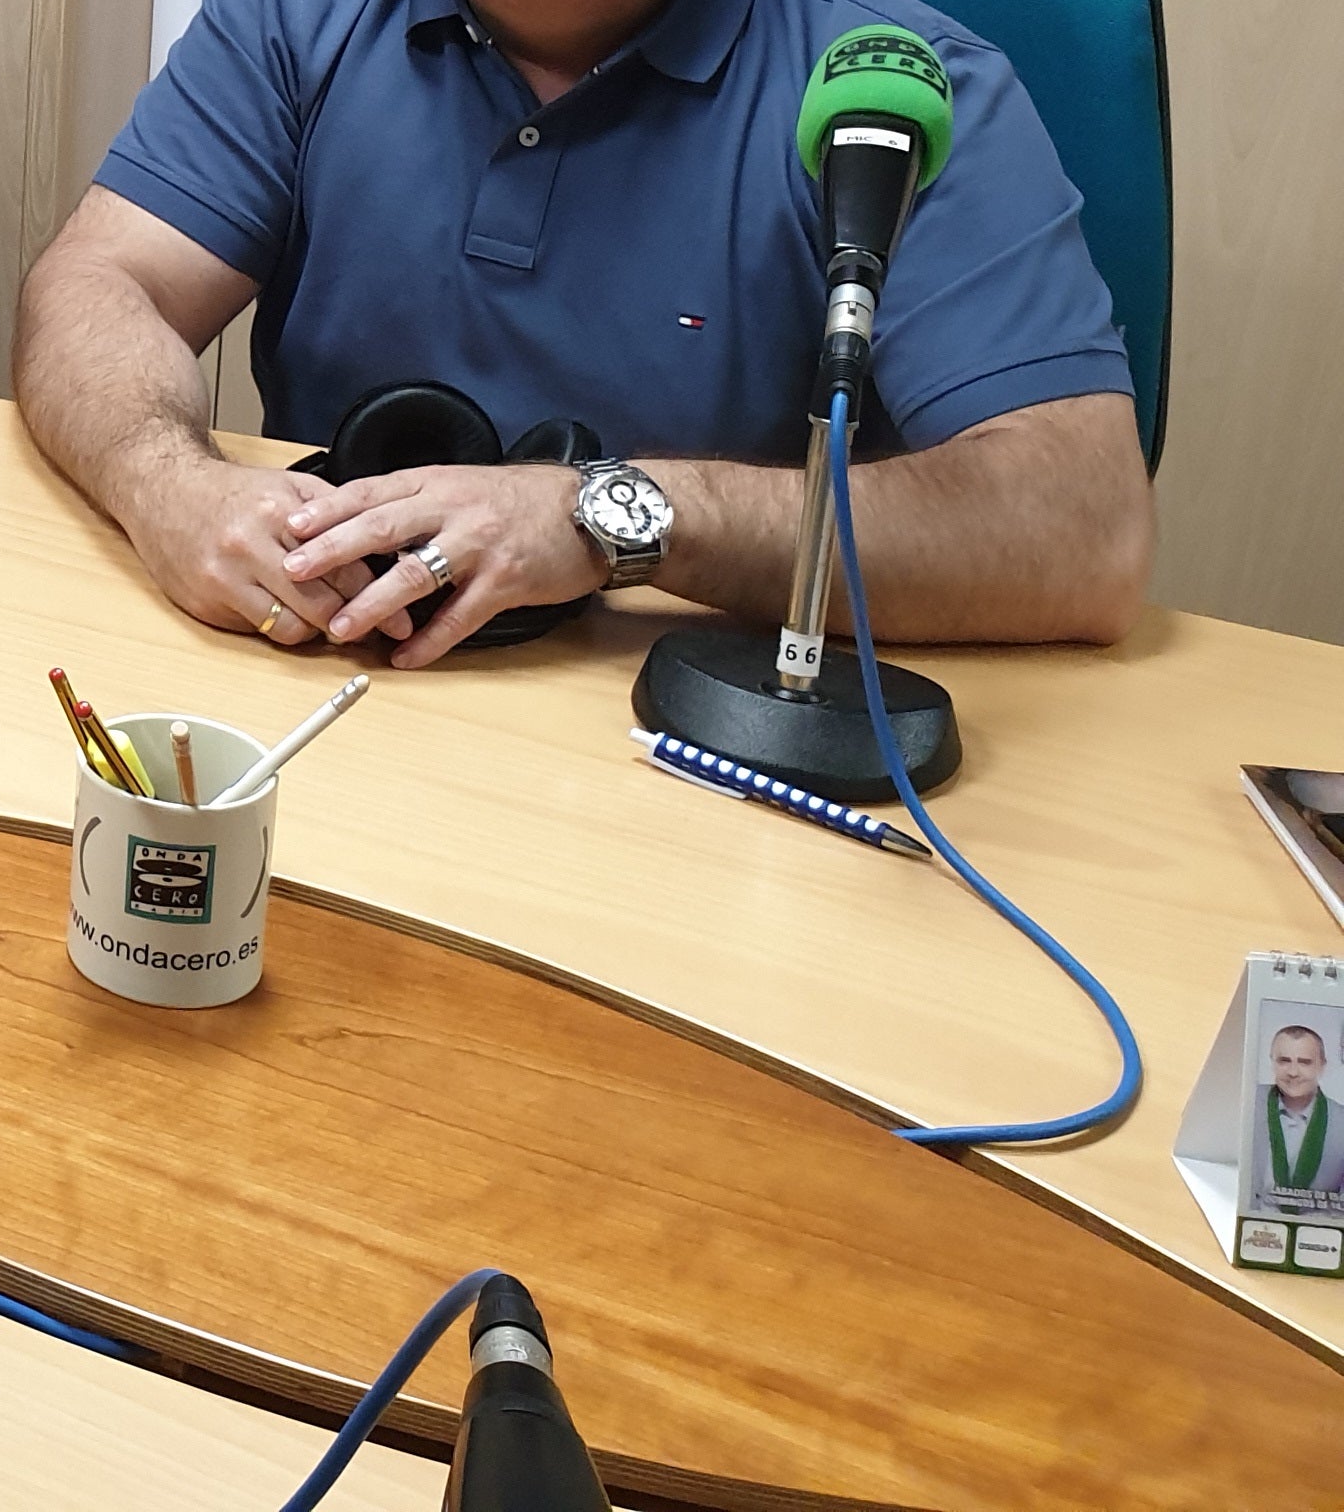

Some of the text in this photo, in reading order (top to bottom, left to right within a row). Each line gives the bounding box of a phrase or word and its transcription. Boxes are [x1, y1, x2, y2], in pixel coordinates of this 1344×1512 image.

[846, 53, 937, 80] CERO
[784, 643, 818, 664] 6 6
[141, 847, 202, 862] ONDA
[133, 885, 199, 905] CERO
[70, 902, 259, 972] ww.ondacero.es
